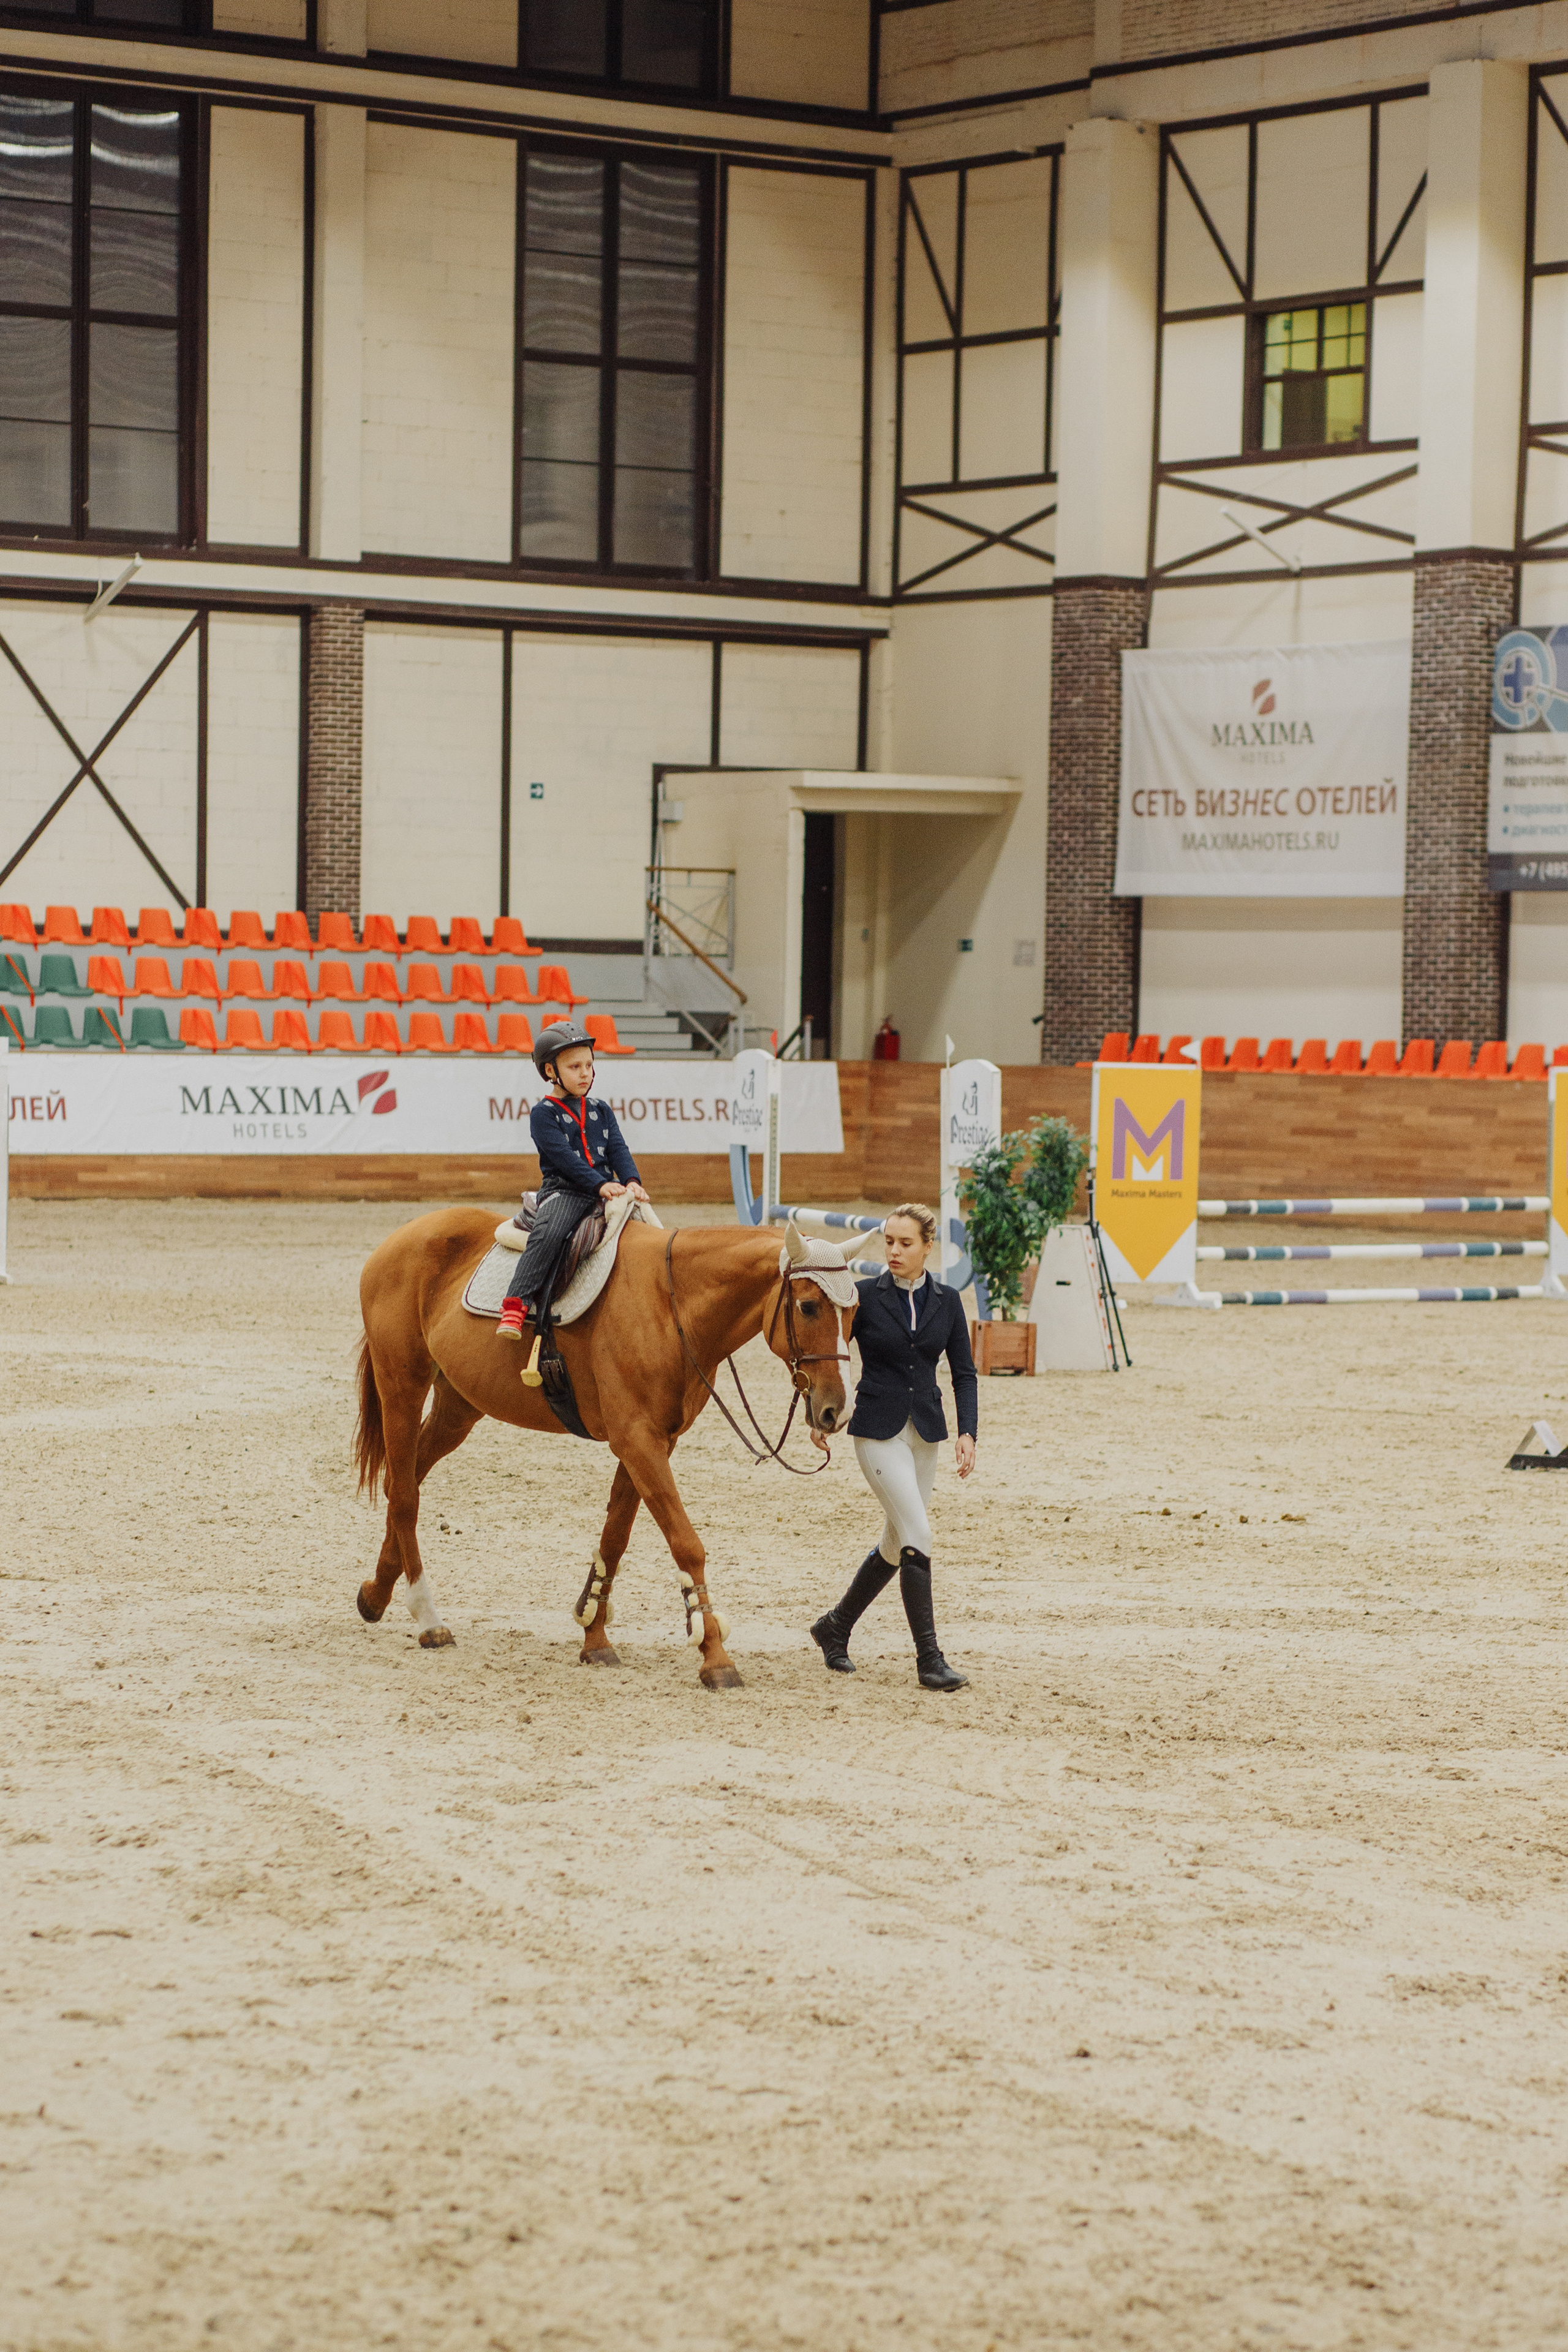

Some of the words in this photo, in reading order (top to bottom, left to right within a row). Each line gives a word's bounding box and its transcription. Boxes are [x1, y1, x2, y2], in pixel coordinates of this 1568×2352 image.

[1212, 720, 1314, 747] MAXIMA
[1240, 751, 1285, 764] HOTELS
[1131, 789, 1187, 816] СЕТЬ
[1195, 788, 1289, 816] БИЗНЕС
[1296, 777, 1398, 815] ОТЕЛЕЙ
[1182, 832, 1340, 851] MAXIMAHOTELS.RU
[9, 1090, 66, 1121] ЛЕЙ
[179, 1086, 355, 1115] MAXIMA
[233, 1123, 307, 1138] HOTELS
[1111, 1189, 1146, 1198] Maxima
[1149, 1189, 1183, 1198] Masters
